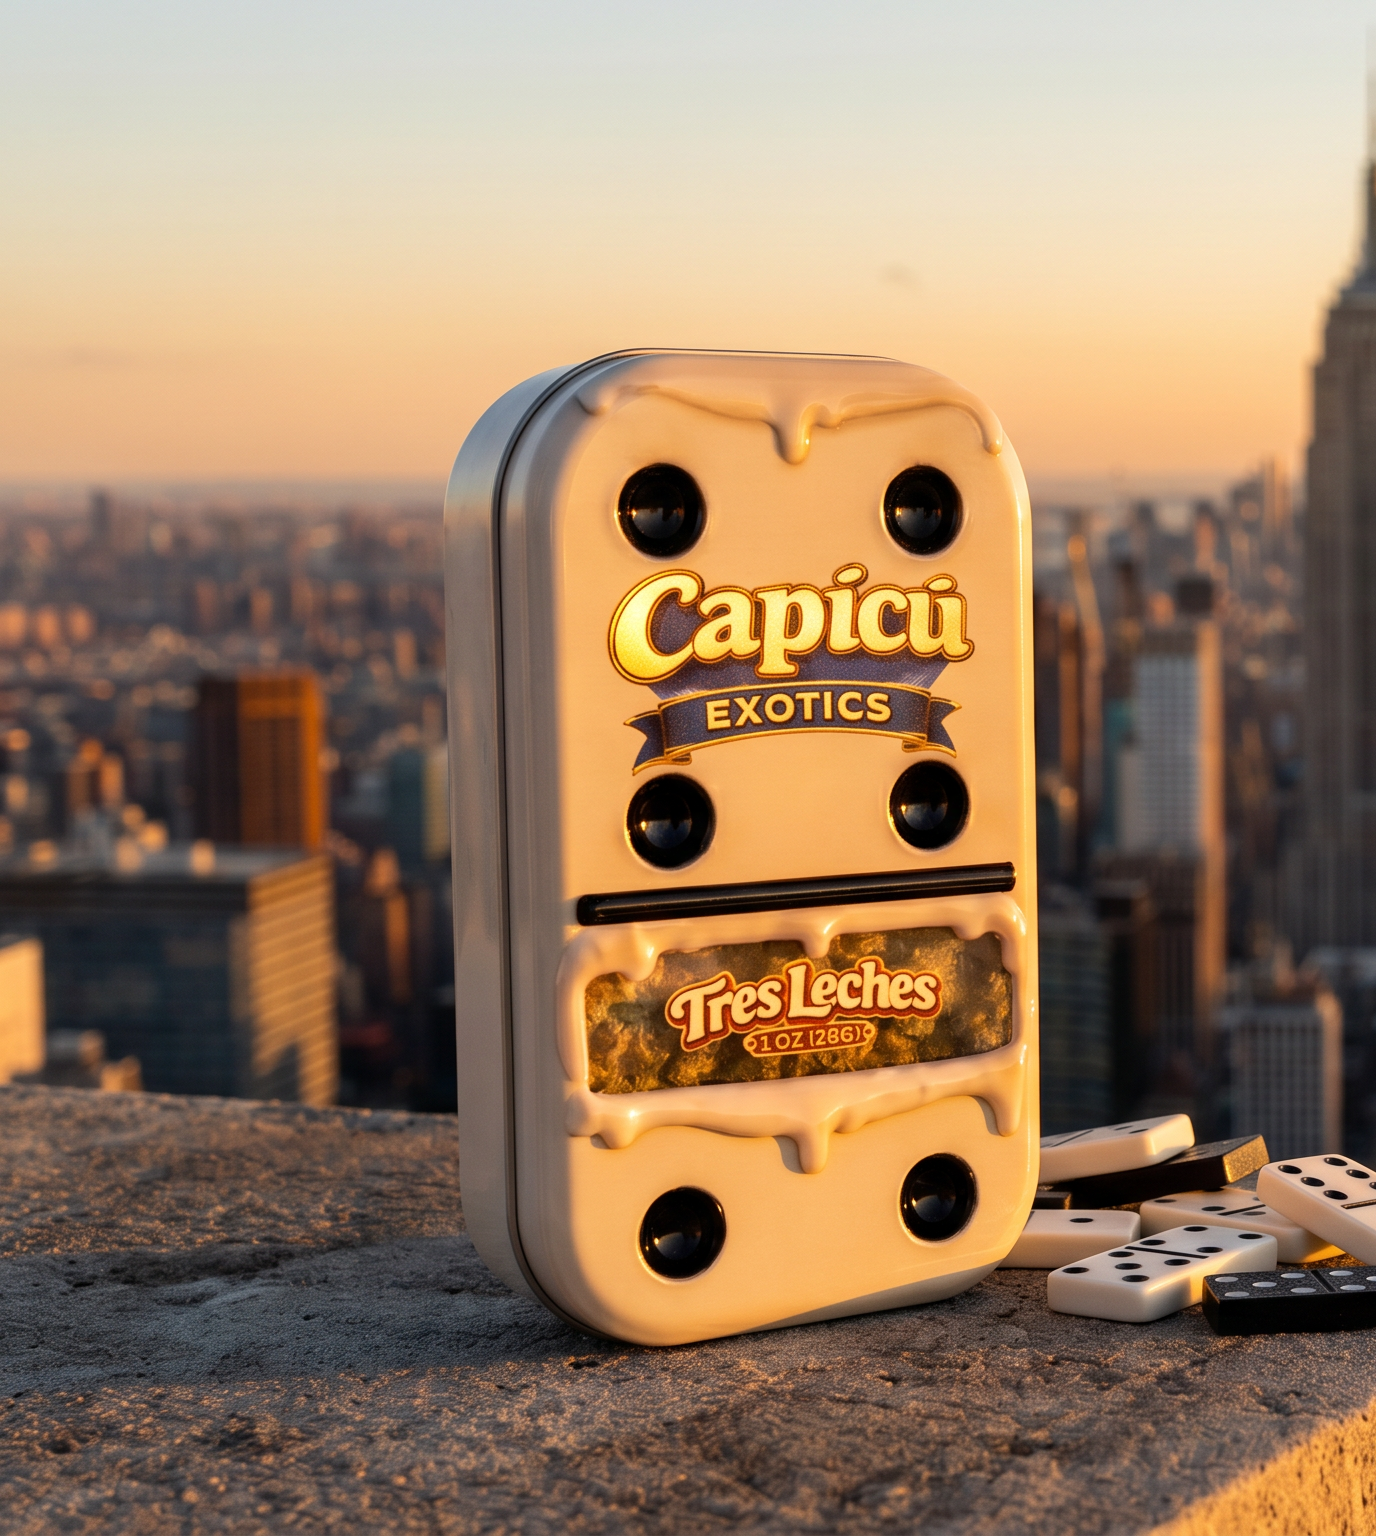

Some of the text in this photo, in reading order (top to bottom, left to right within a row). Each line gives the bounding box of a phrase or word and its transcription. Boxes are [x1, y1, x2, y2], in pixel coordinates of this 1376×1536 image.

[706, 691, 891, 730] EXOTICS
[667, 958, 941, 1048] Tres Leches
[760, 1036, 772, 1051] 1
[775, 1032, 804, 1050] OZ
